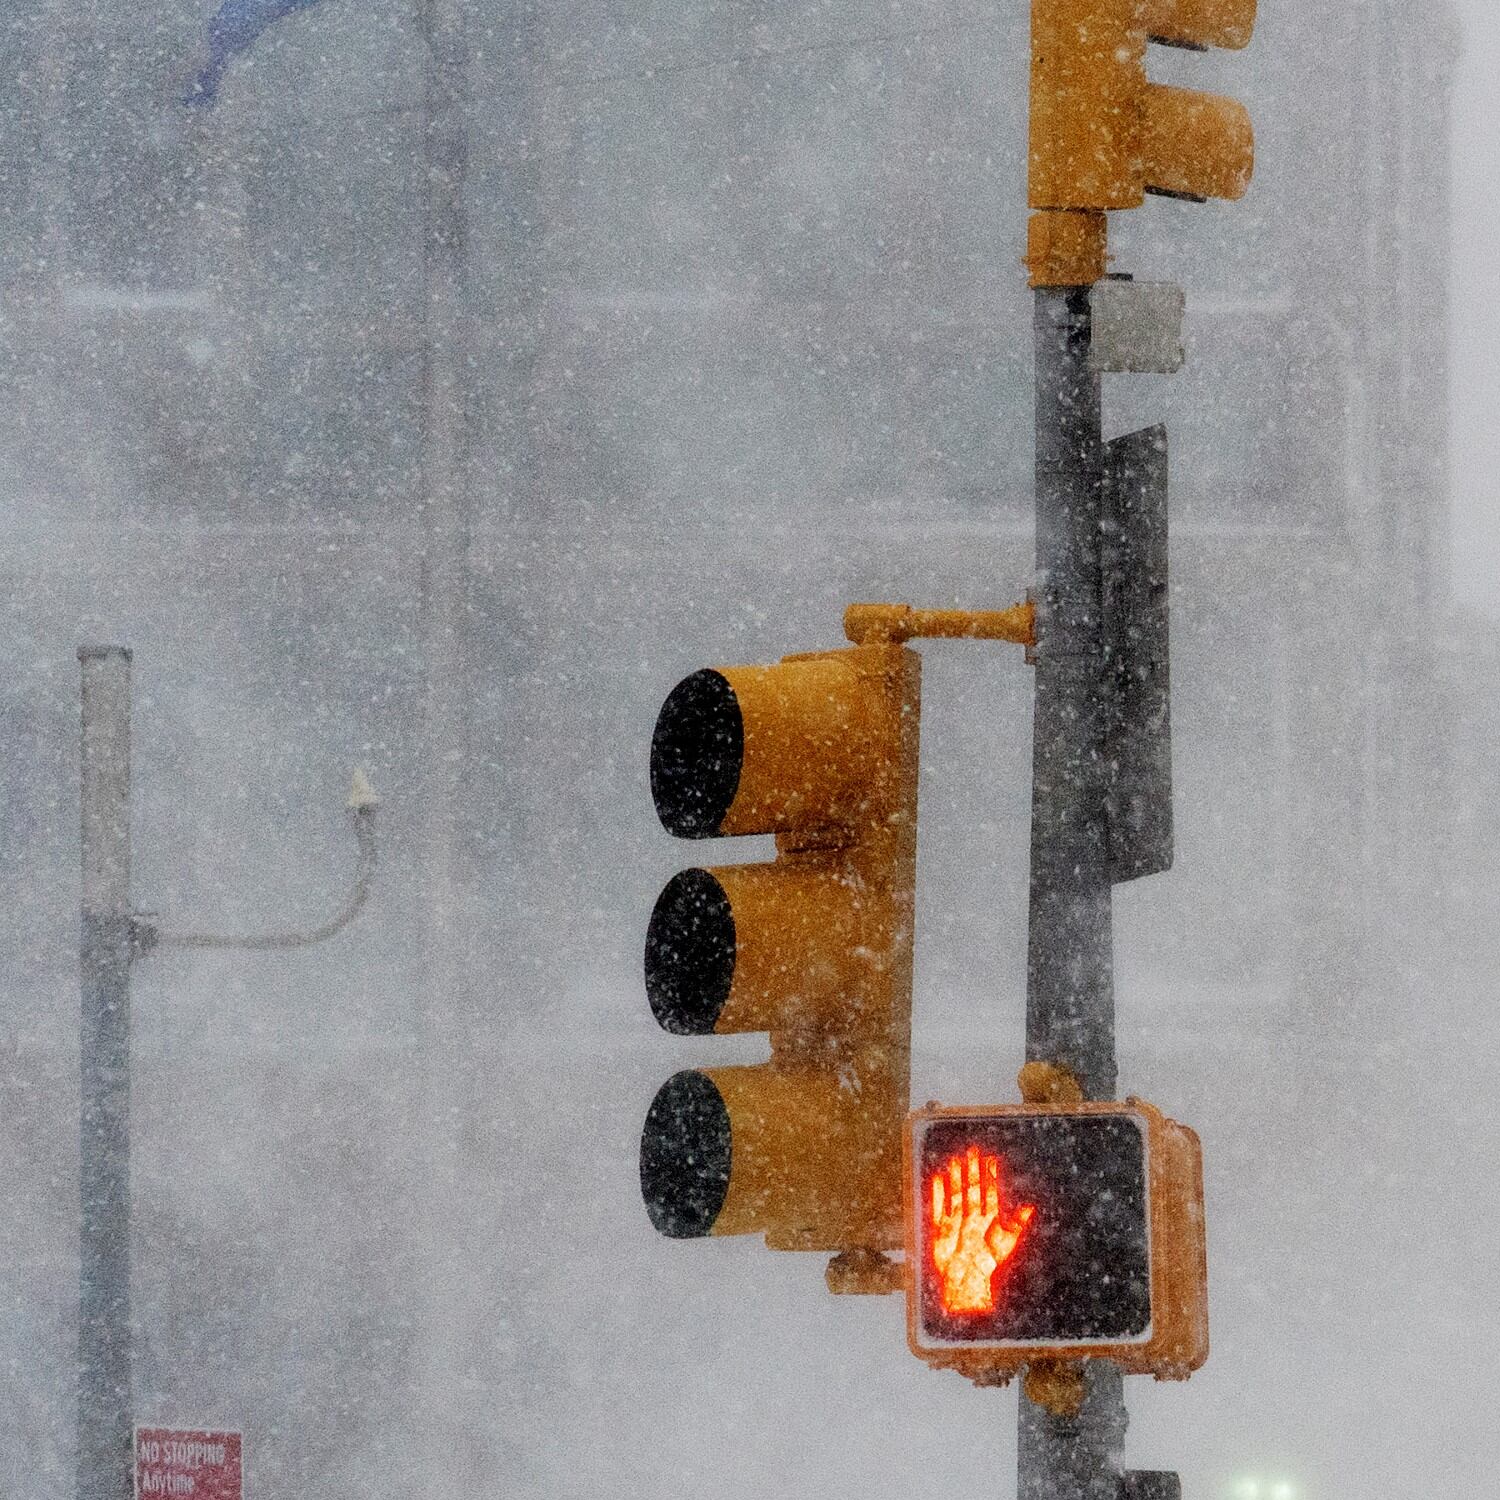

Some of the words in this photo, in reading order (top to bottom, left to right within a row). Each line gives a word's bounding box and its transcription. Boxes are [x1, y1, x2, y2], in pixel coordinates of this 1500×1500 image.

[140, 1441, 160, 1463] NO
[164, 1441, 225, 1466] STOPPING
[142, 1471, 195, 1495] Anytime
